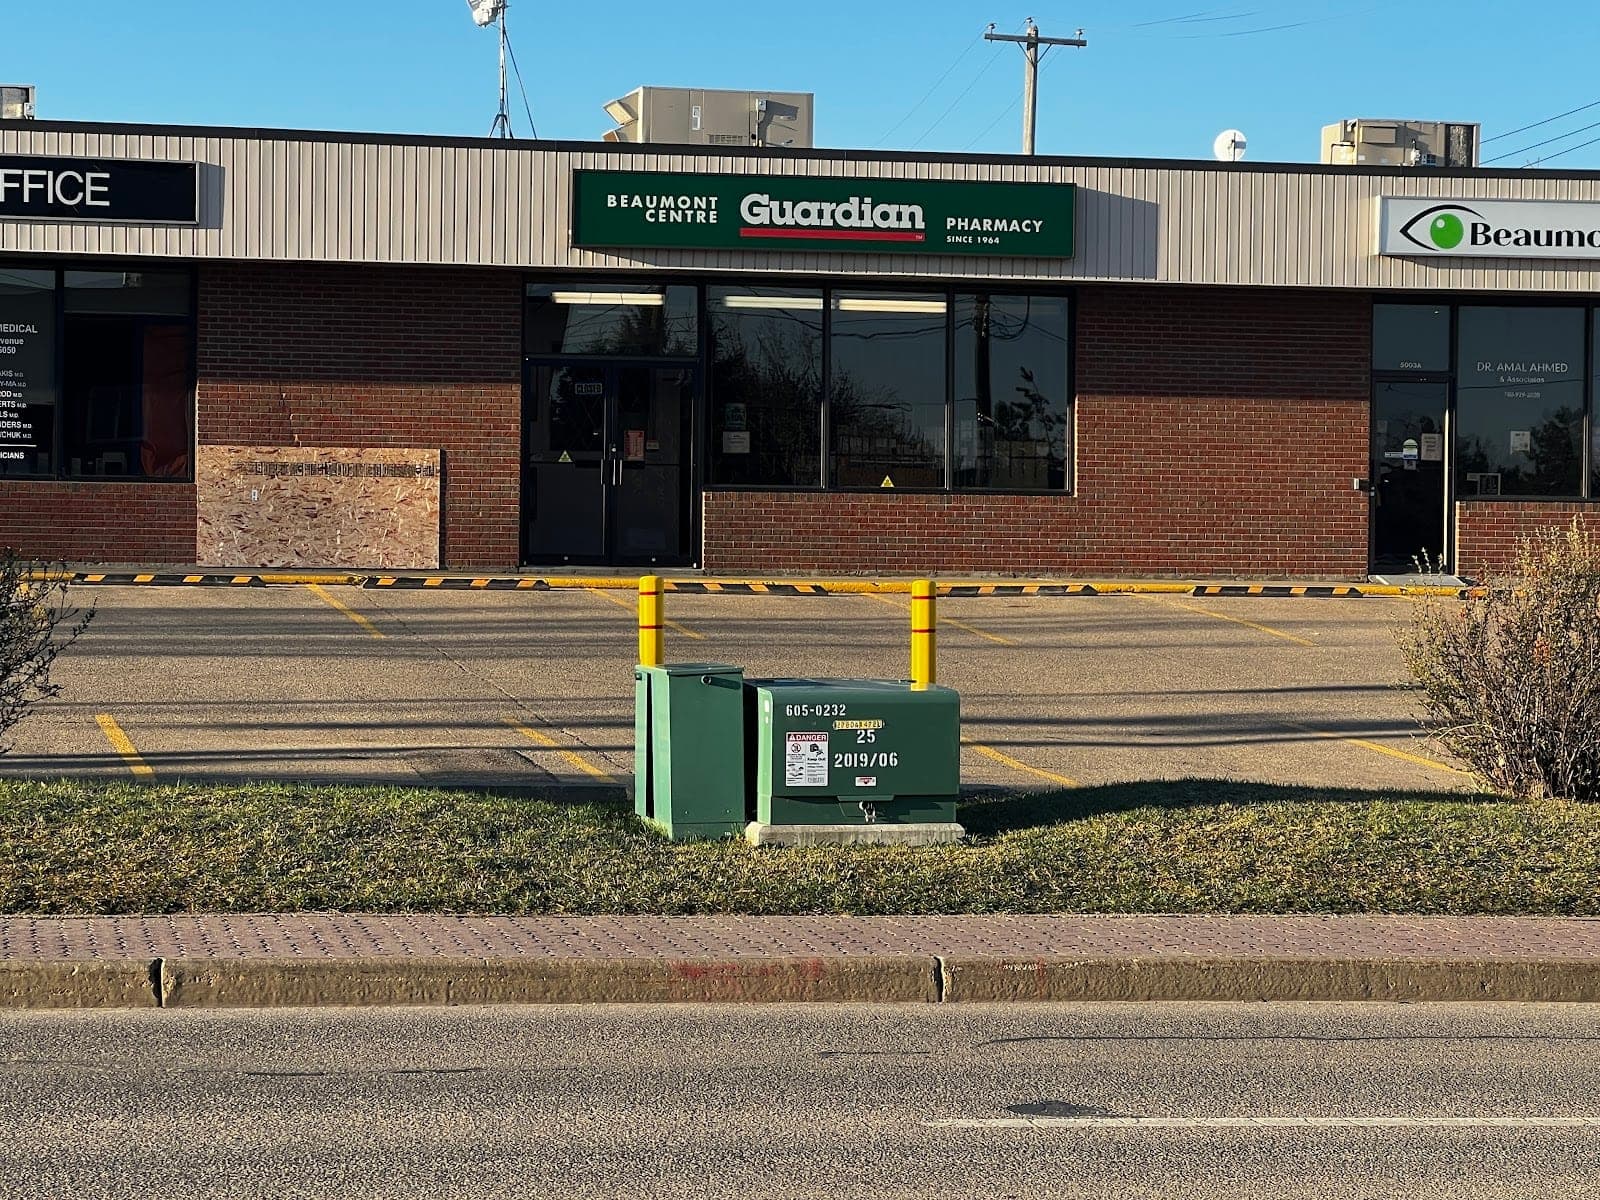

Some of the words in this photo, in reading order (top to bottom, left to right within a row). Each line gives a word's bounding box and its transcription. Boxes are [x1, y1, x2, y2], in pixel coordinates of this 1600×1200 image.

[607, 195, 718, 209] BEAUMONT
[645, 210, 718, 223] CENTRE
[740, 193, 925, 229] Guardian
[946, 218, 1043, 232] PHARMACY
[1477, 362, 1494, 372] DR.
[1497, 363, 1526, 372] AMAL
[1530, 363, 1568, 373] AHMED
[786, 704, 846, 716] 605-0232
[856, 729, 876, 744] 25
[834, 753, 898, 767] 2019/06
